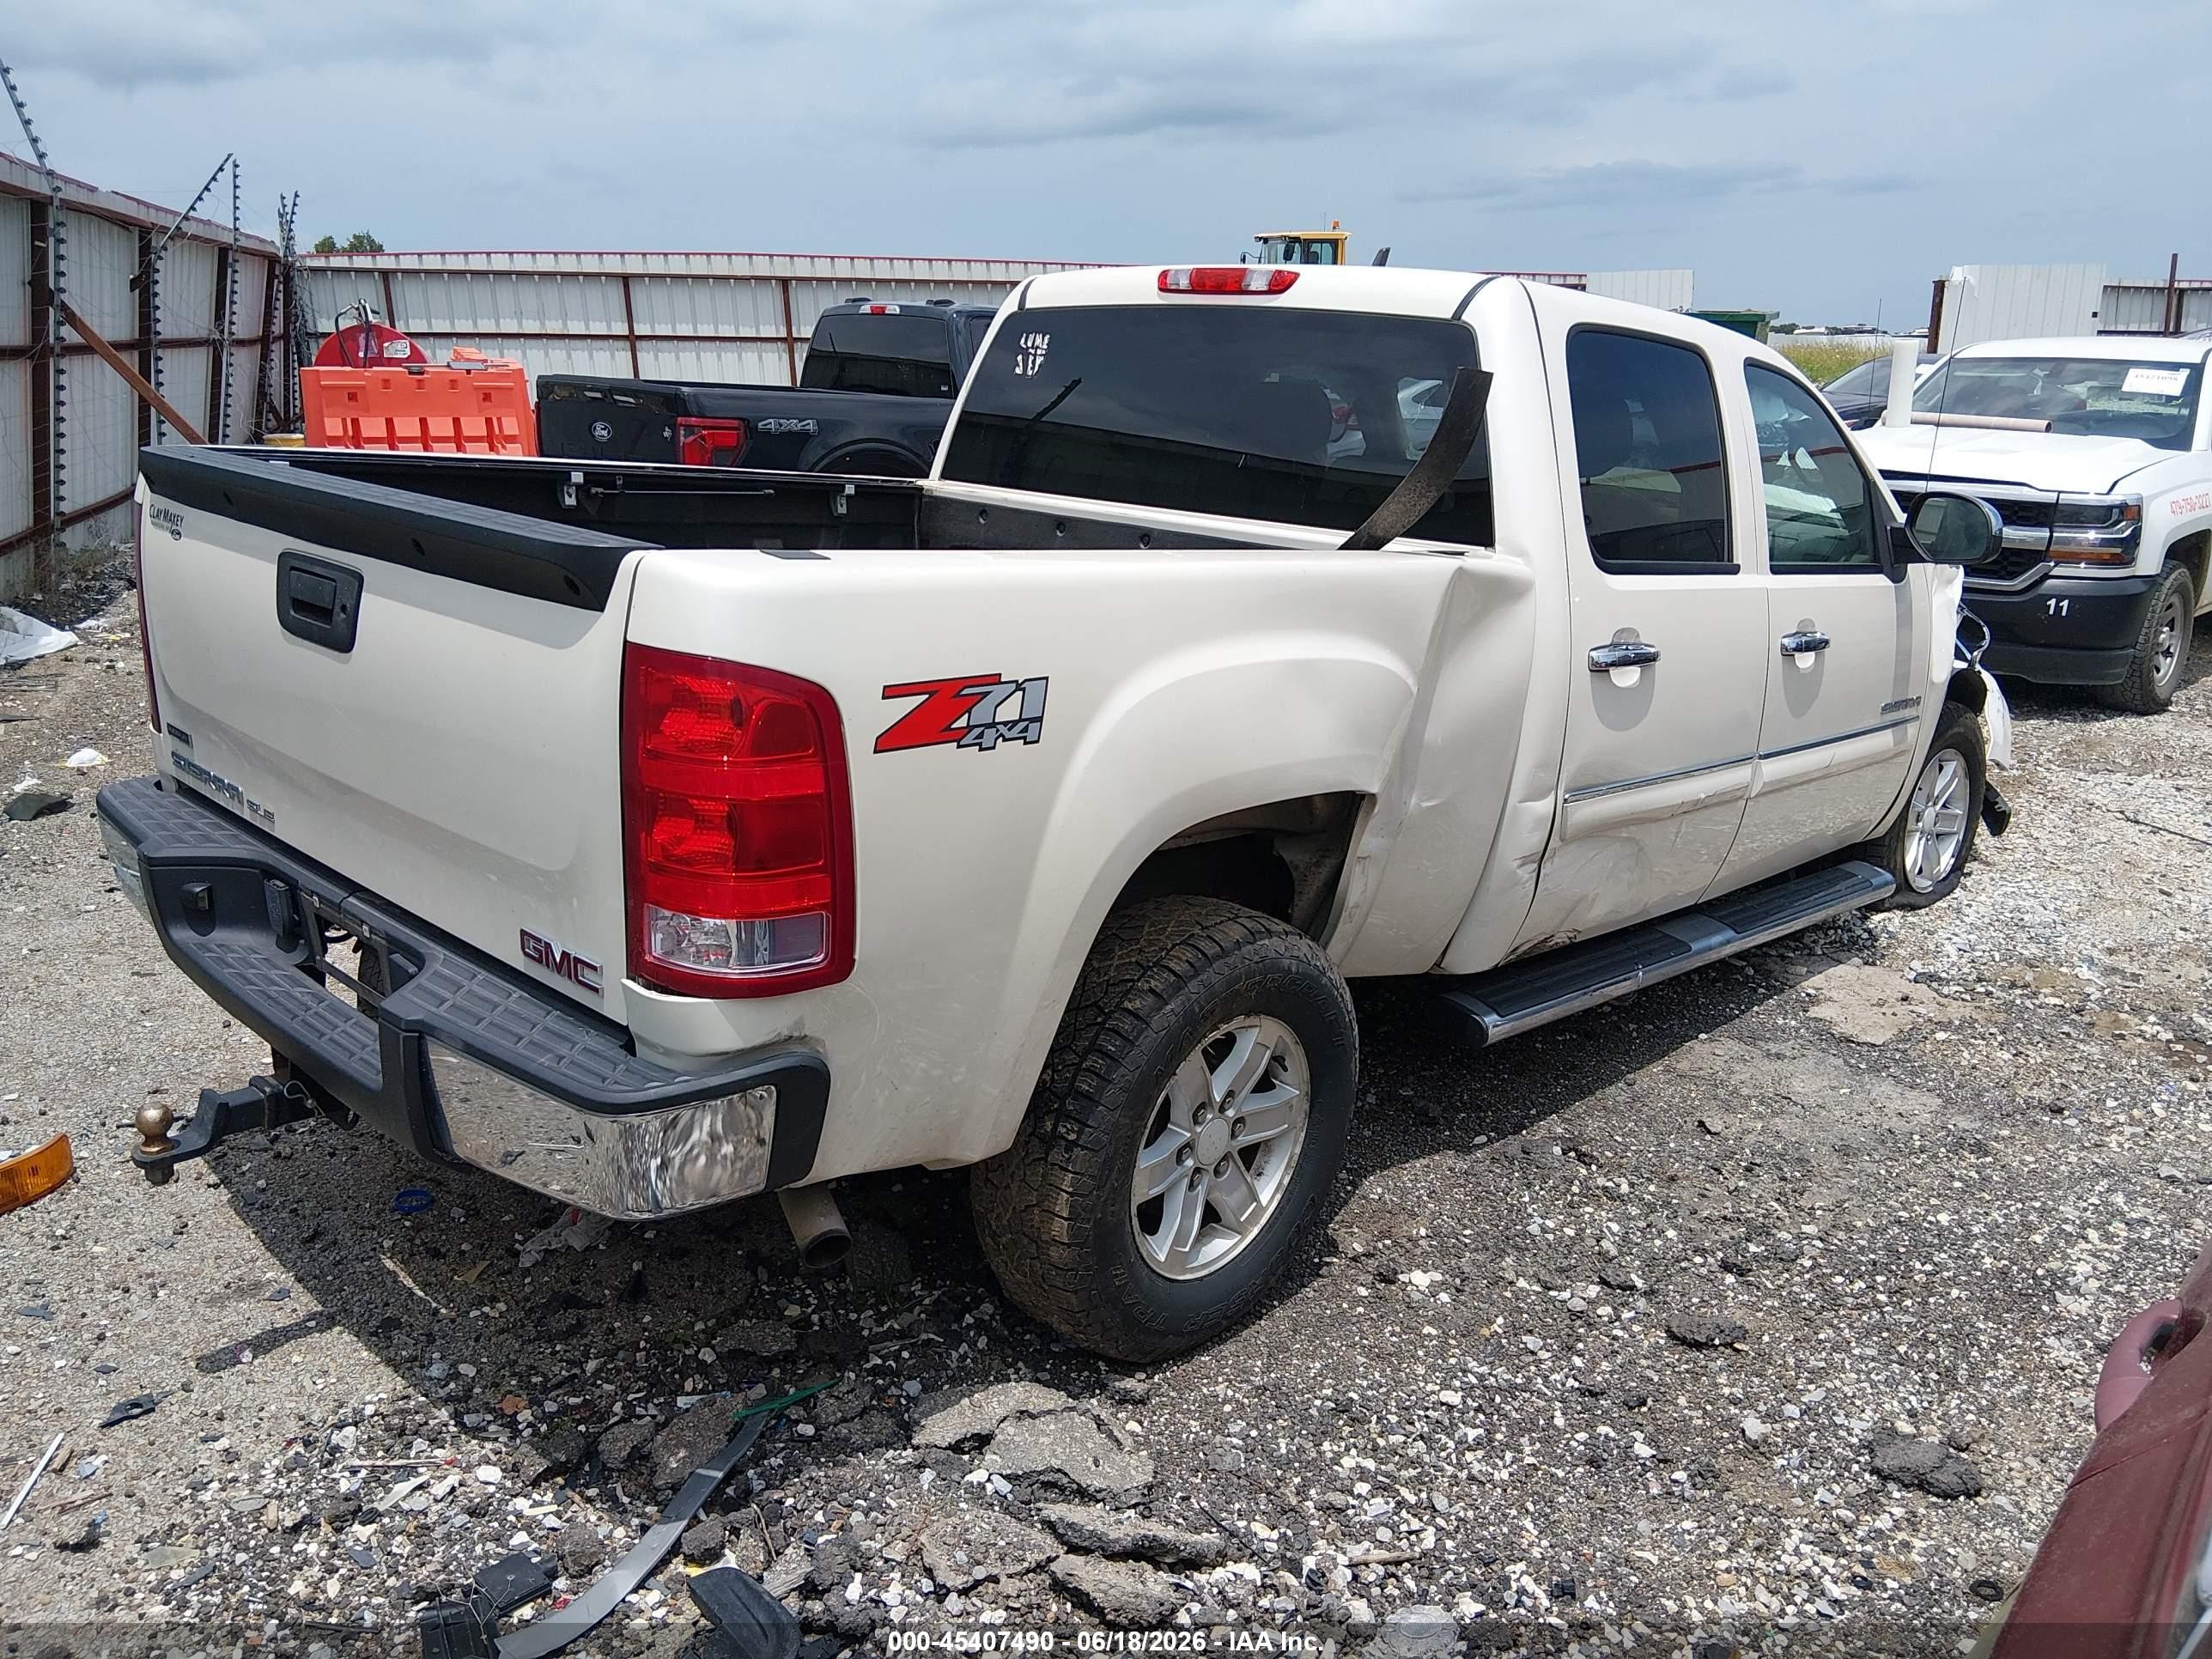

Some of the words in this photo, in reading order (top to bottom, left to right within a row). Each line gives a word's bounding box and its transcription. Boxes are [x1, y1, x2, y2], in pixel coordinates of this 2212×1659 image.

[593, 423, 609, 437] Ford
[2047, 598, 2069, 617] 11
[873, 673, 1048, 754] Z71
[520, 927, 604, 997] GMC
